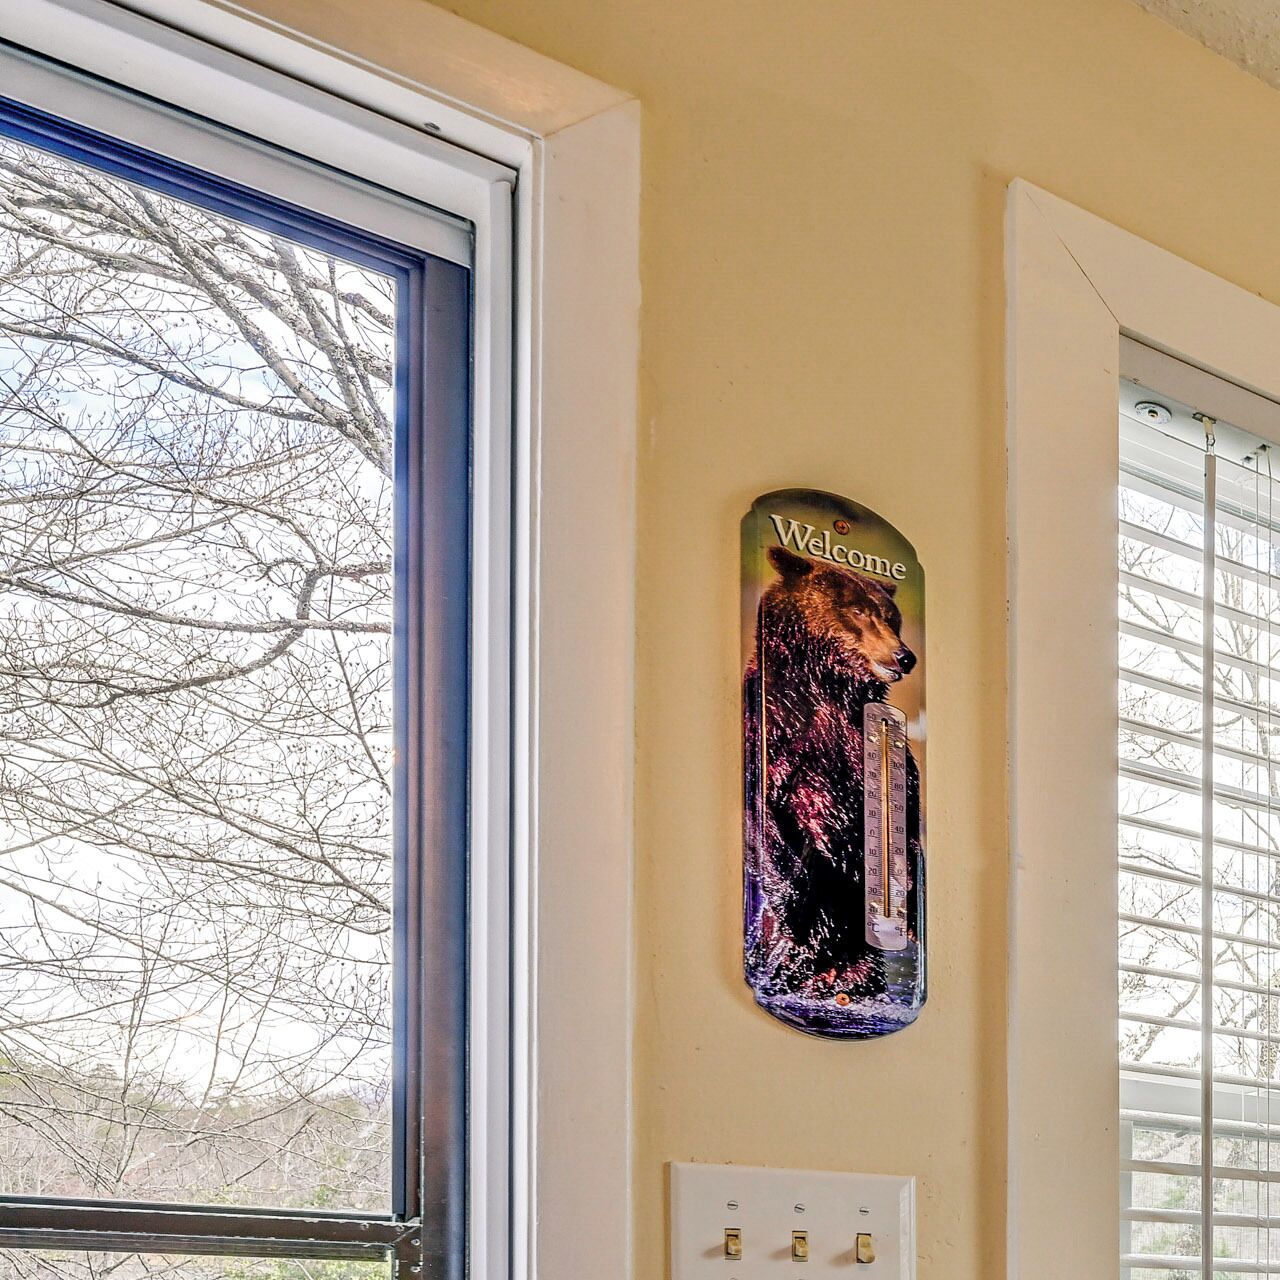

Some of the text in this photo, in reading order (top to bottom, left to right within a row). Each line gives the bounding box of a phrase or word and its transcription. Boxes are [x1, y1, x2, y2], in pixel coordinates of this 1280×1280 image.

[769, 513, 907, 580] Welcome
[893, 761, 904, 769] 100
[868, 887, 878, 895] 30
